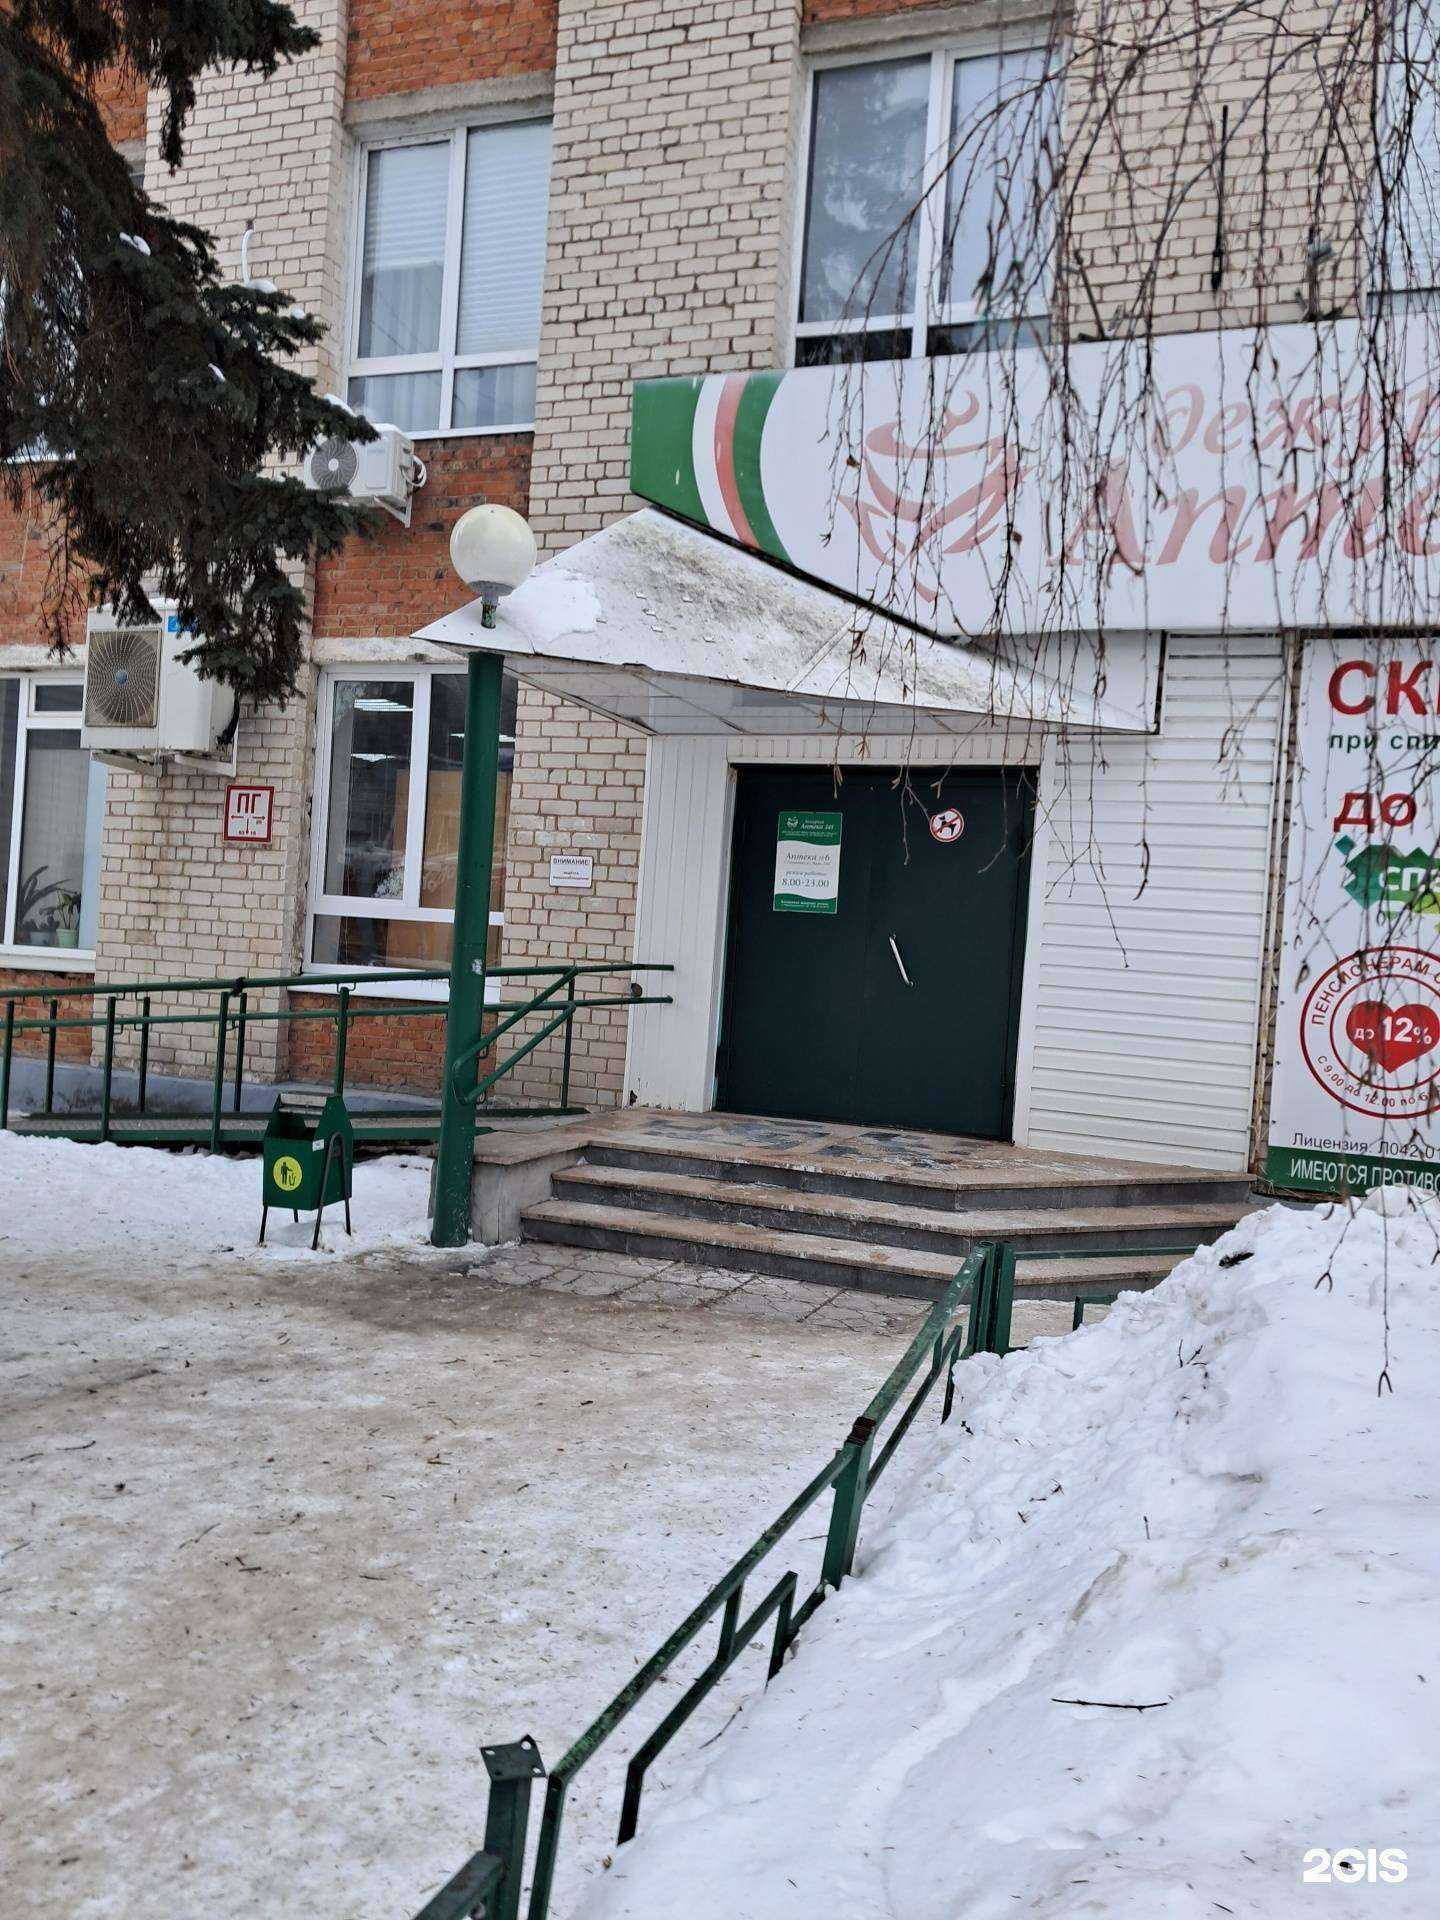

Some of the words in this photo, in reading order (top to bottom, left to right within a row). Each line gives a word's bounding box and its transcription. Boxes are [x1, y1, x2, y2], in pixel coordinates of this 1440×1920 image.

[1329, 660, 1440, 716] СК
[1330, 734, 1377, 754] при
[237, 793, 261, 814] ПГ
[1312, 956, 1431, 1025] ПЕНСИОНЕРАМ
[1290, 1158, 1368, 1186] ИМЕЮТСЯ
